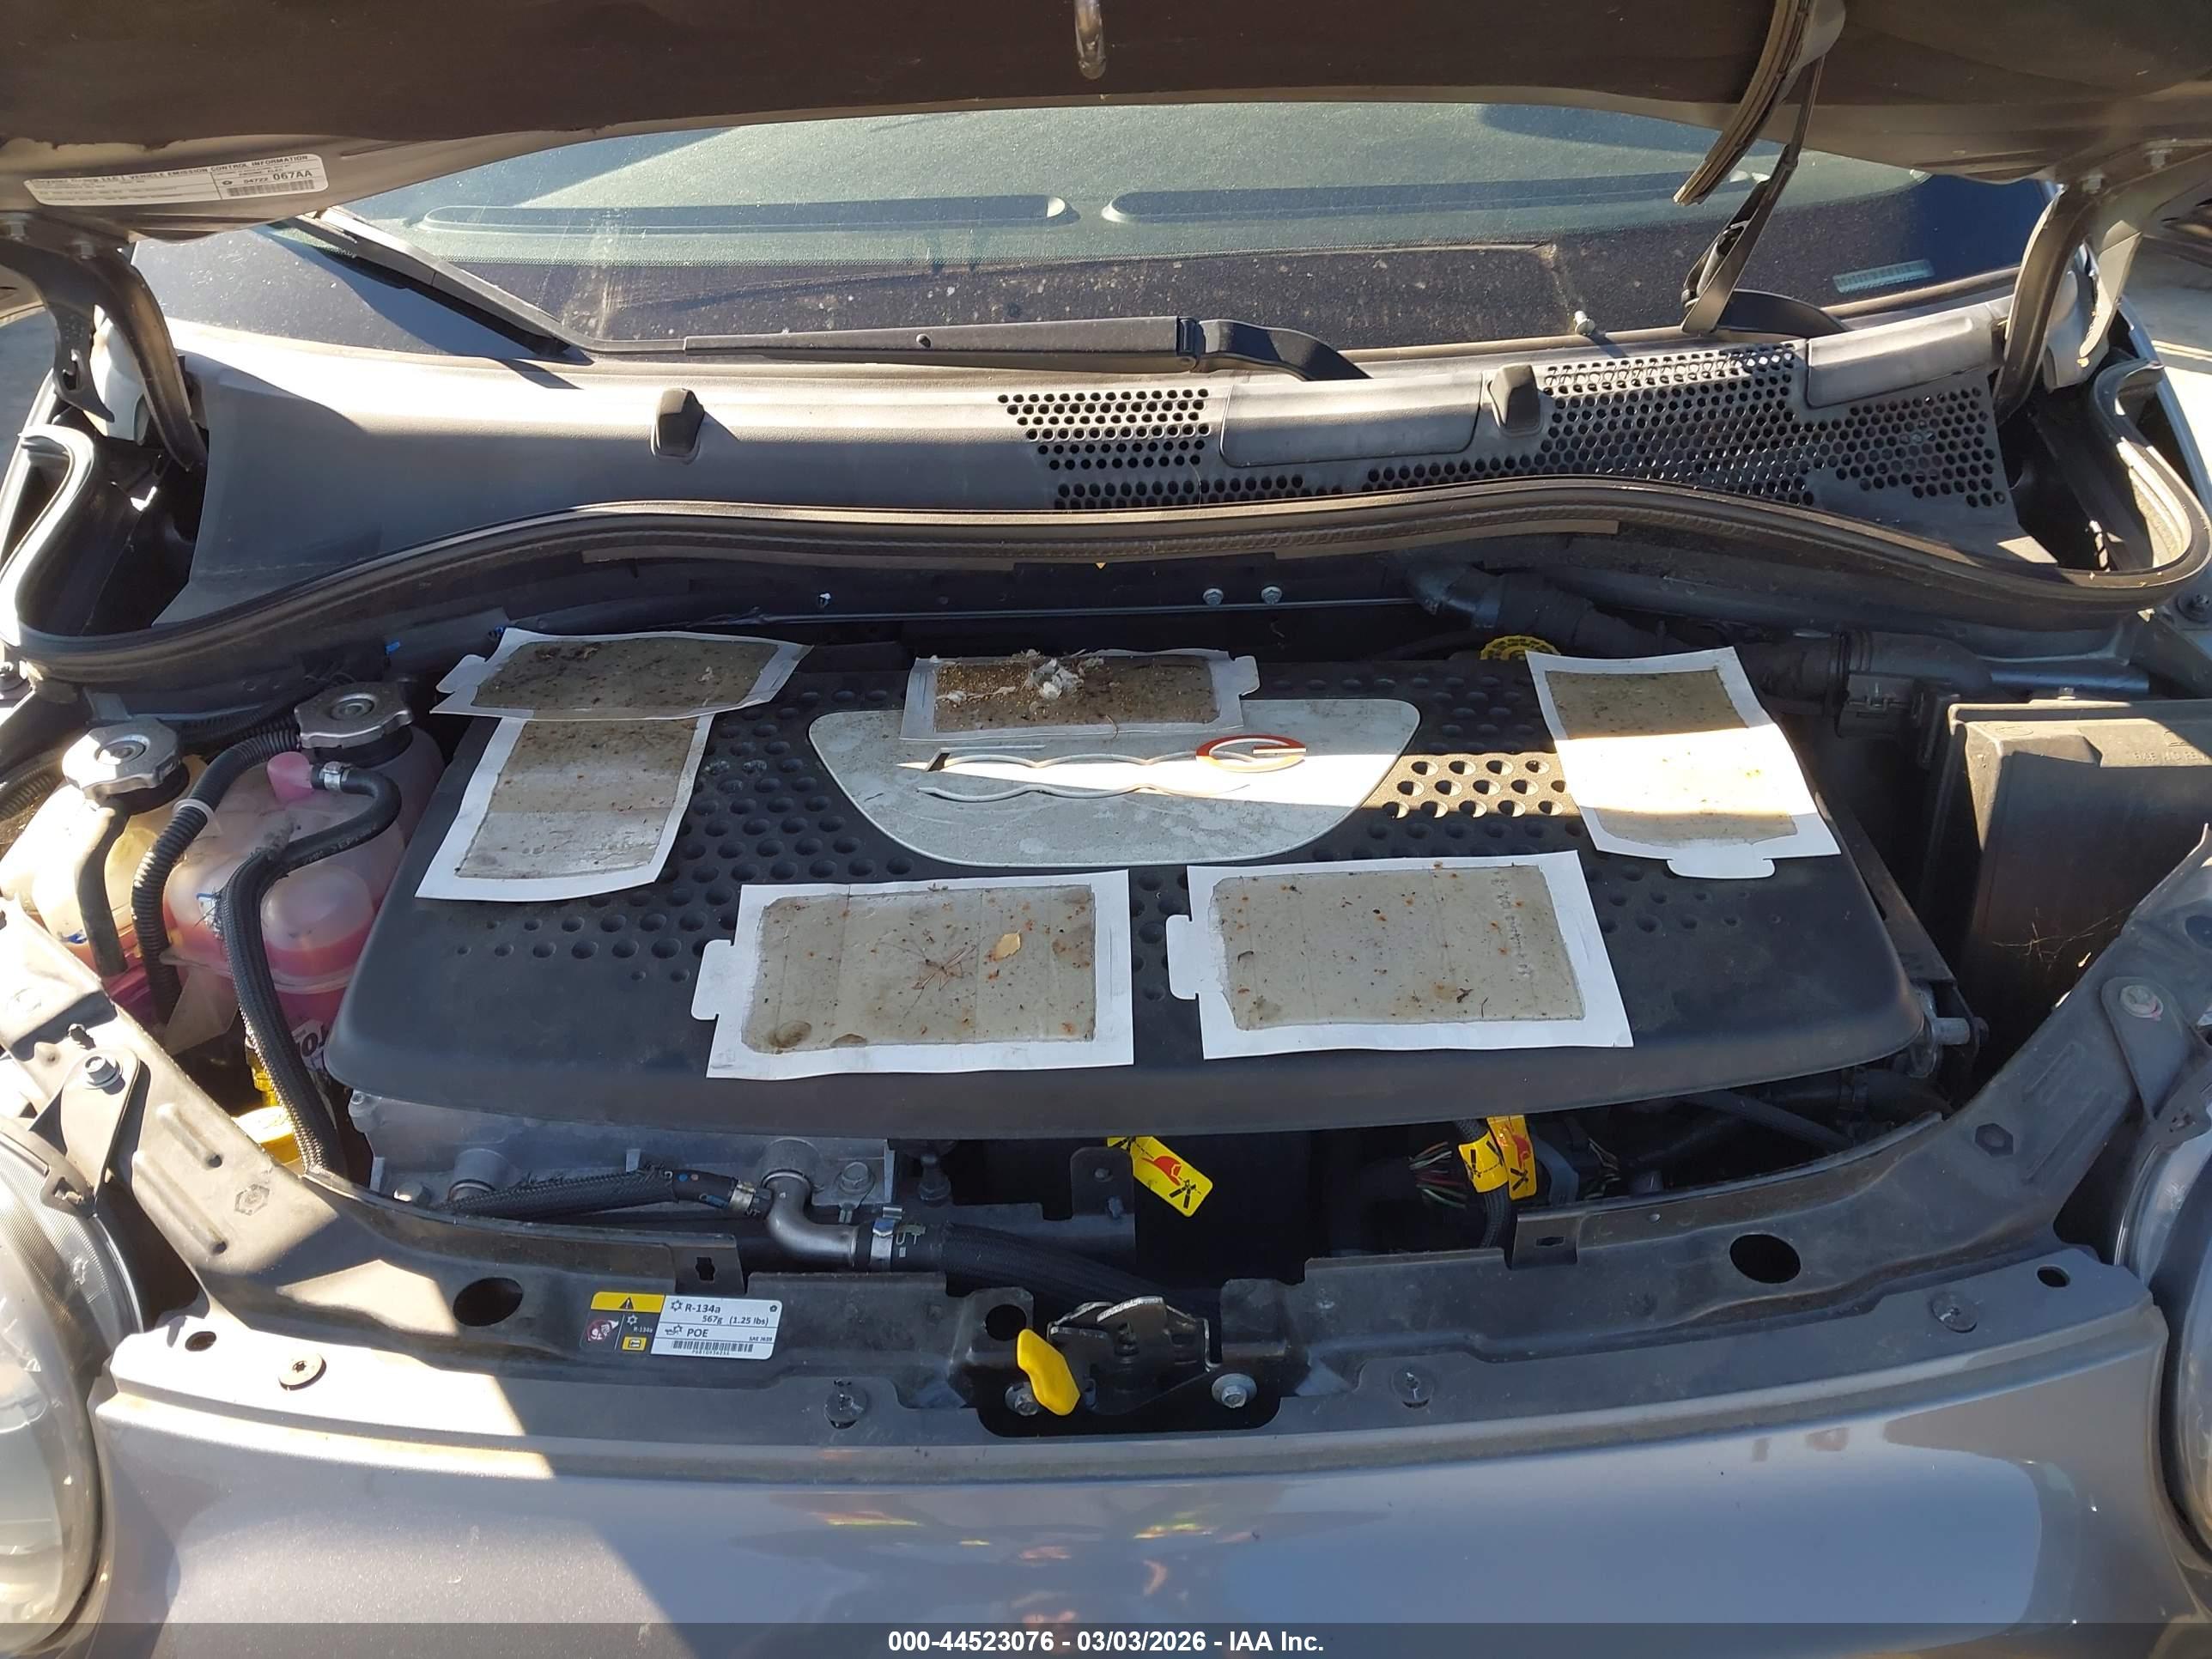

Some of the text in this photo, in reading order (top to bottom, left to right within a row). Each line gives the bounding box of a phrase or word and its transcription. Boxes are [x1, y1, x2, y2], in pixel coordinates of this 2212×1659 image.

[167, 167, 209, 176] EMISSION
[210, 162, 249, 173] CONTROL
[251, 155, 309, 167] INFORMATION
[273, 170, 313, 182] 067AA
[684, 1303, 721, 1314] R-134a
[702, 1315, 769, 1327] 567g (1.25 lbs)
[686, 1328, 709, 1339] POE
